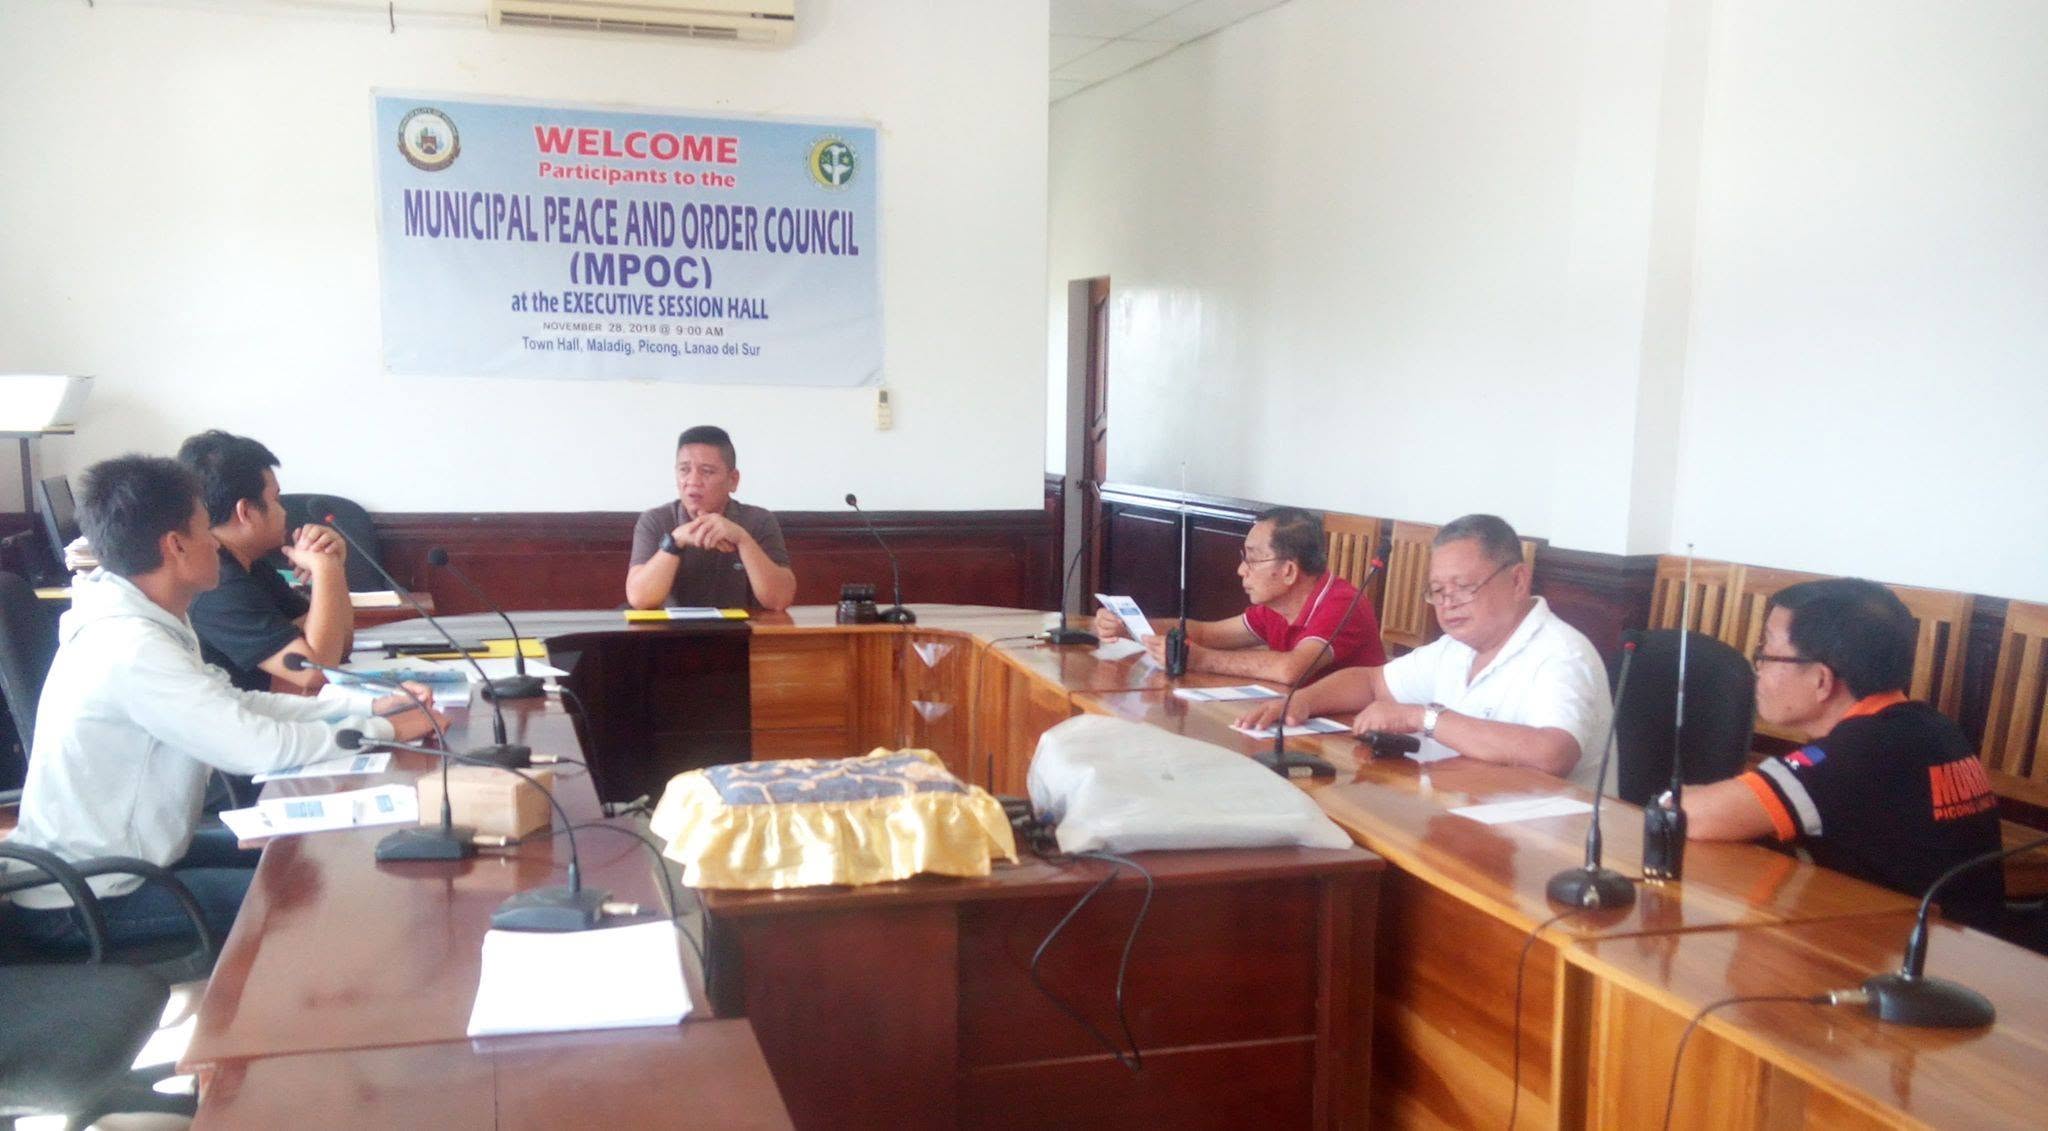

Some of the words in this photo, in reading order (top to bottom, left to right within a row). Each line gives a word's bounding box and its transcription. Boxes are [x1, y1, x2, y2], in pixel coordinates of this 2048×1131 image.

[534, 125, 738, 164] WELCOME
[538, 161, 667, 185] Participants
[674, 169, 695, 186] to
[701, 171, 736, 188] the
[404, 188, 538, 242] MUNICIPAL
[544, 196, 618, 246] PEACE
[624, 200, 675, 248] AND
[681, 202, 758, 252] ORDER
[764, 206, 859, 256] COUNCIL
[570, 251, 713, 290] (MPOC)
[511, 291, 528, 312] at
[532, 291, 559, 313] the
[563, 291, 653, 317] EXECUTIVE
[658, 295, 723, 319] SESSION
[728, 297, 769, 320] HALL
[543, 321, 602, 332] NOVEMBER
[630, 324, 656, 334] 2018
[659, 326, 671, 335] @
[705, 327, 724, 337] AM
[522, 336, 554, 351] Town
[557, 338, 583, 354] Hall,
[586, 339, 635, 356] Maladig,
[638, 339, 681, 358] Picong,
[684, 341, 719, 355] Lanao
[721, 342, 739, 356] del
[742, 342, 761, 357] Sur
